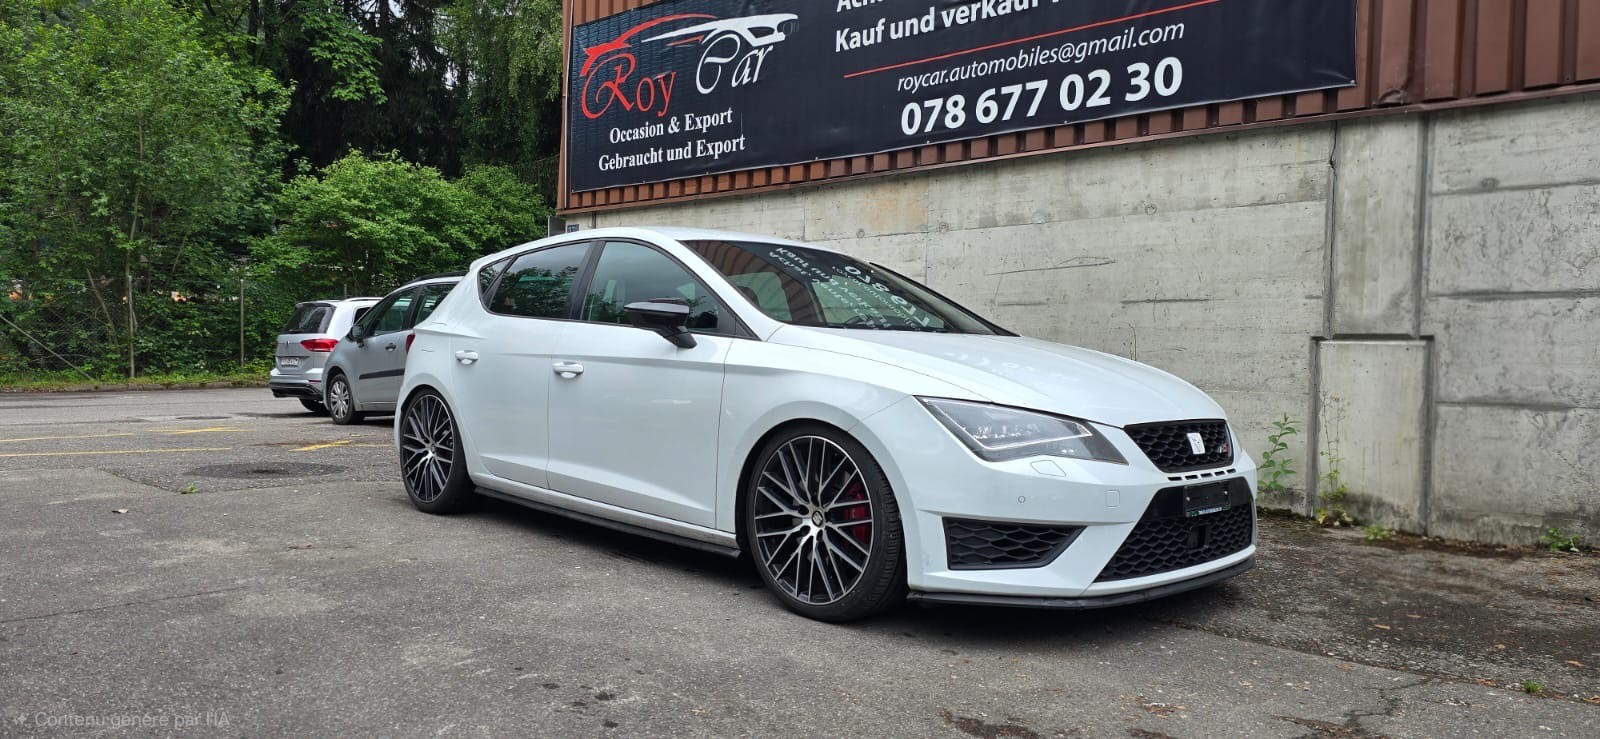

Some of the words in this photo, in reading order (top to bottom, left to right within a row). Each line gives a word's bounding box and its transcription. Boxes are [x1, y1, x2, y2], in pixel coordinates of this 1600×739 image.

[835, 18, 886, 52] Kauf
[890, 7, 936, 40] und
[941, 0, 1039, 28] verkau
[580, 53, 677, 119] Roy
[695, 32, 773, 95] Car
[897, 23, 1186, 91] roycar.automobiles@gmail.com
[609, 119, 664, 144] Occasion
[667, 116, 681, 134] &
[684, 107, 734, 135] Export
[900, 94, 966, 136] 078
[975, 79, 1048, 125] 677
[1059, 68, 1112, 112] 02
[1126, 56, 1184, 103] 30
[598, 146, 664, 172] Gebraucht
[666, 141, 693, 162] und
[696, 134, 746, 161] Export
